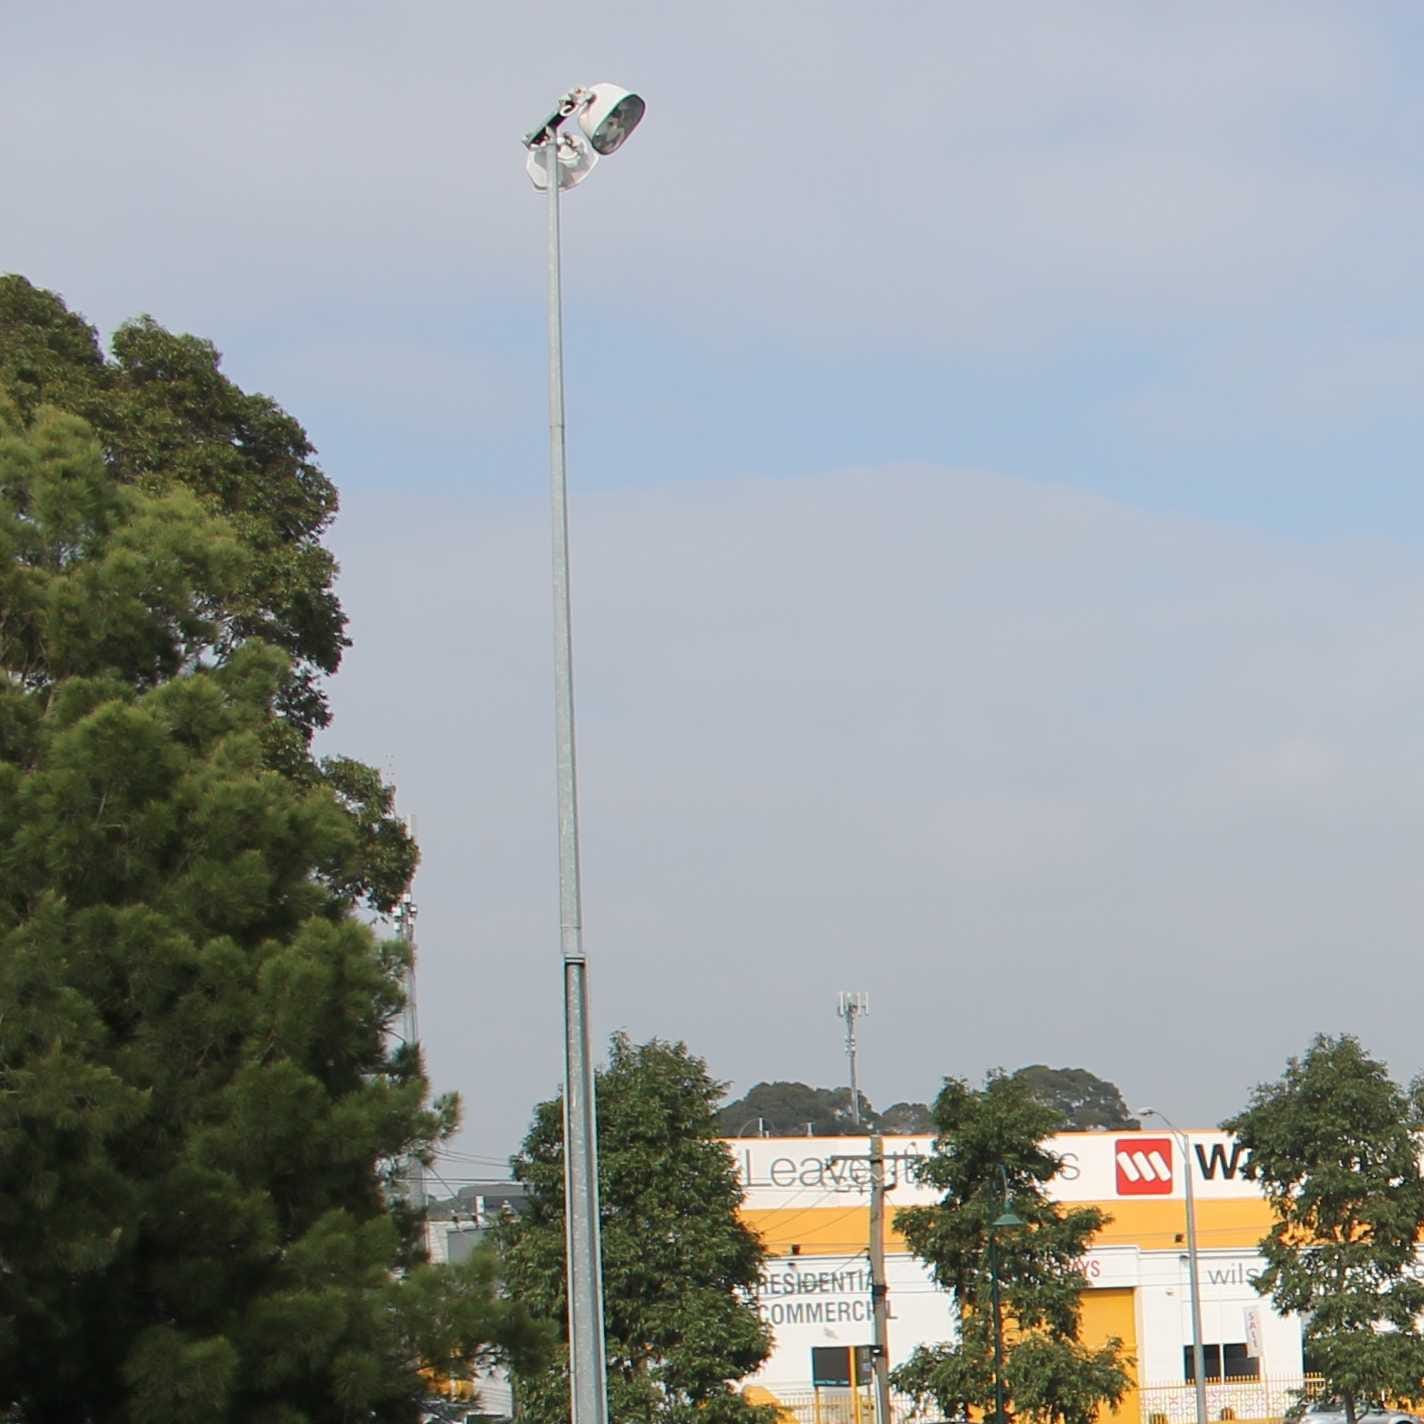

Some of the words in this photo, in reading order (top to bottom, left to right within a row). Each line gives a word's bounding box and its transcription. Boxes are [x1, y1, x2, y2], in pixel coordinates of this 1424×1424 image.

[745, 1149, 873, 1188] Leave
[759, 1269, 873, 1294] RESIDENTIA
[759, 1300, 898, 1325] COMMERCIL
